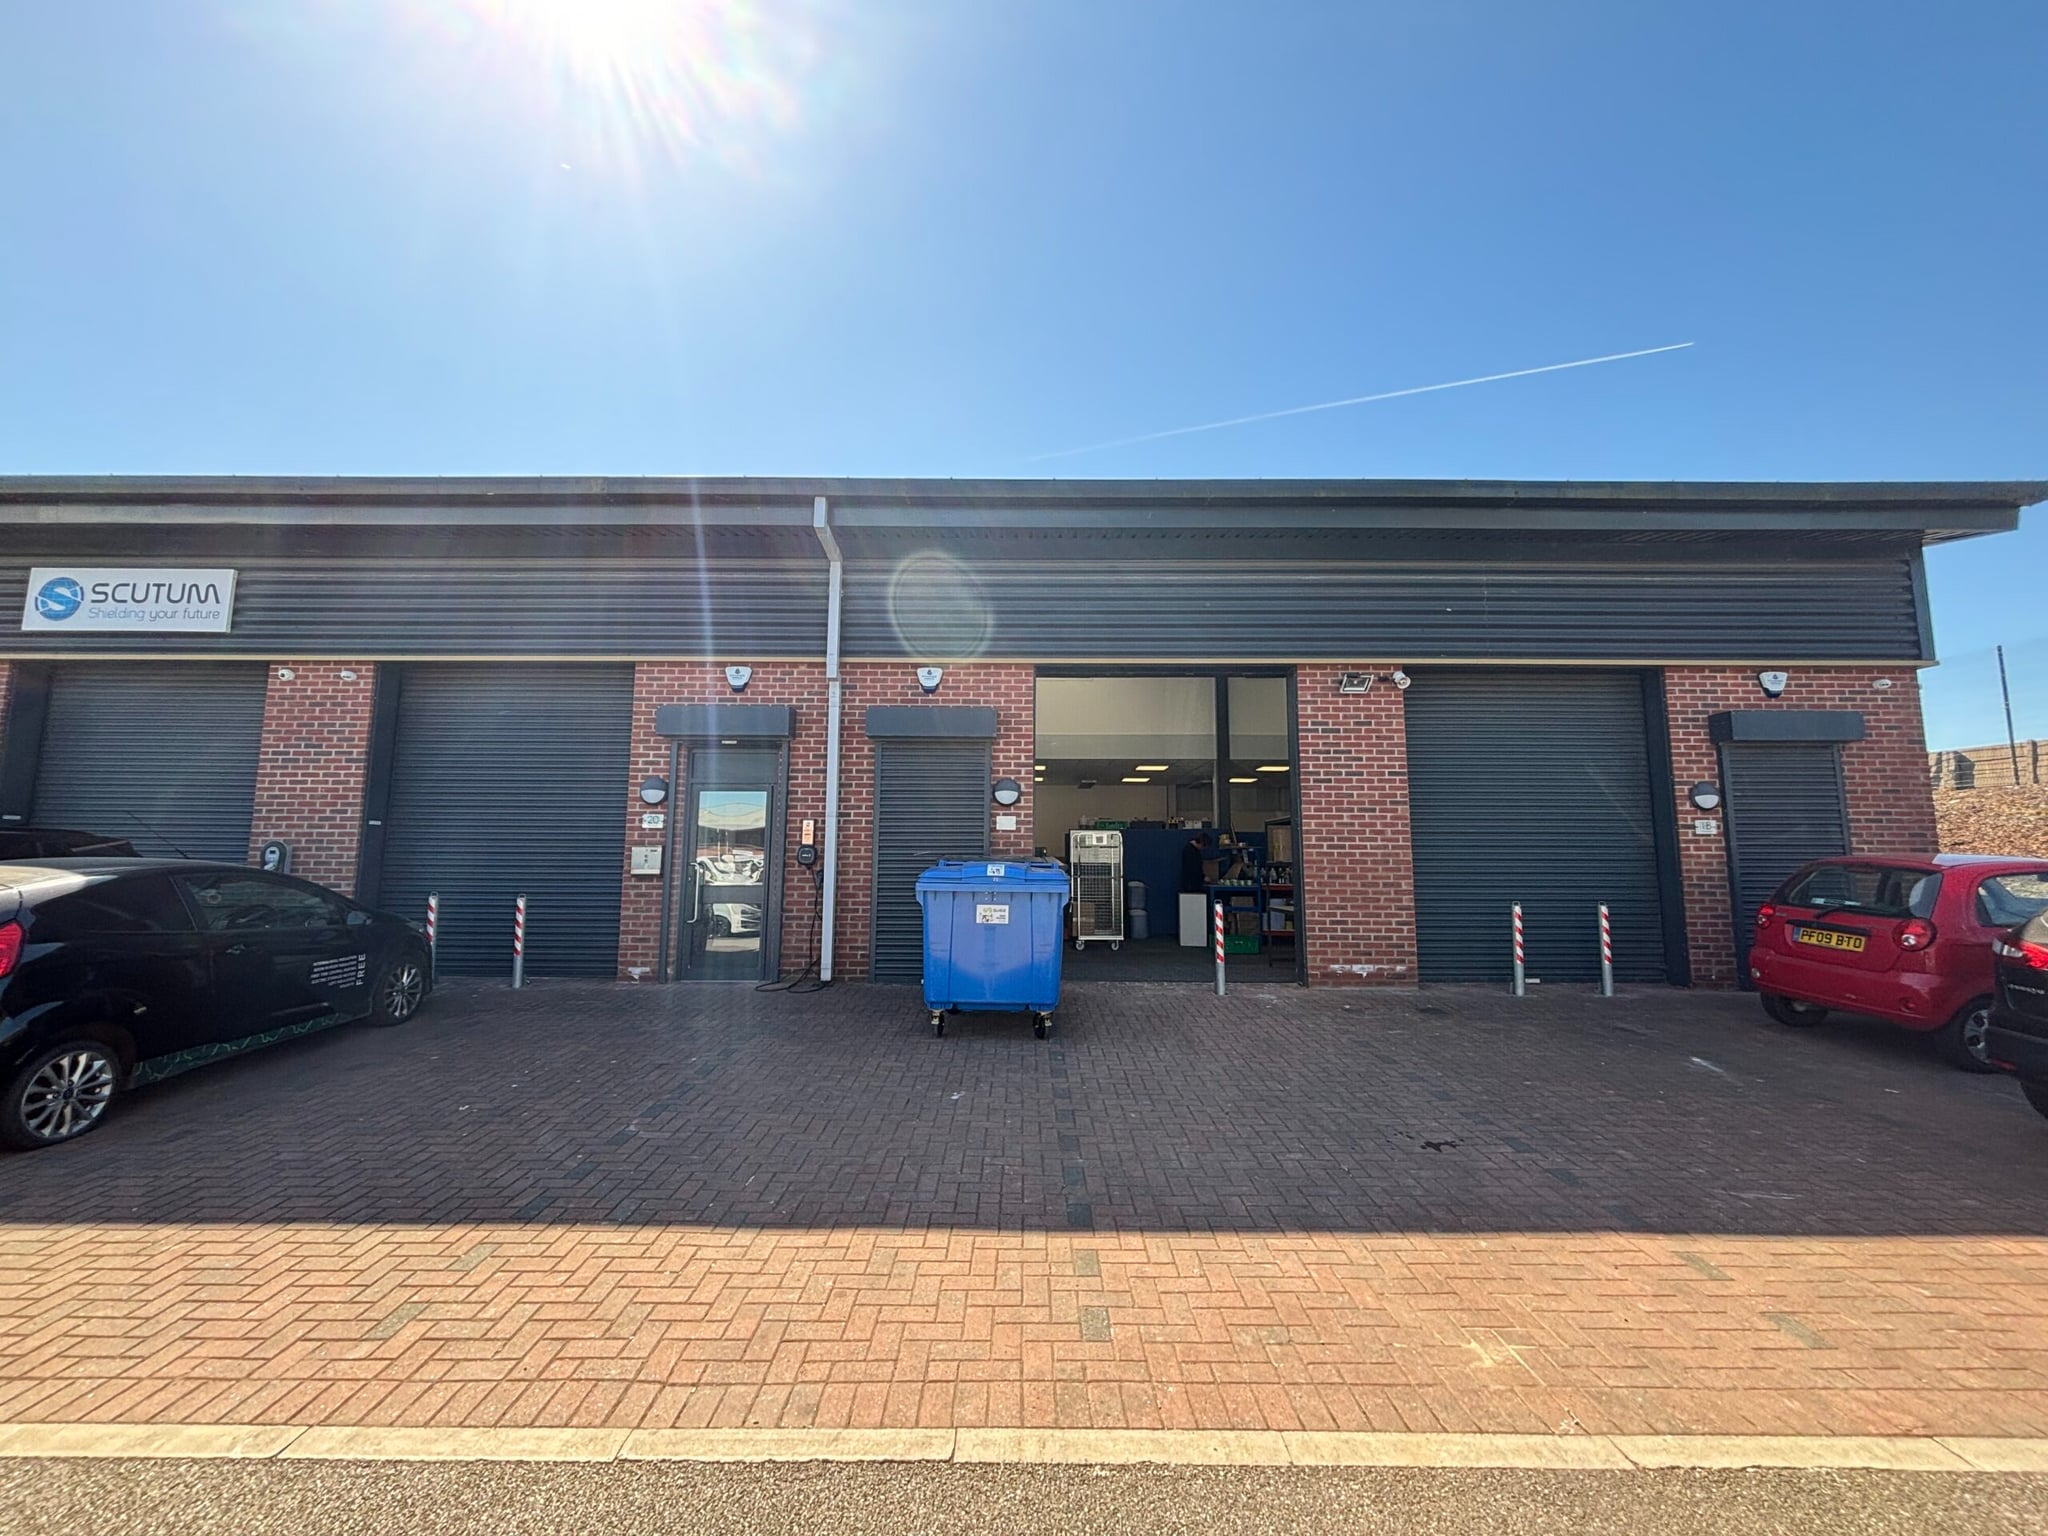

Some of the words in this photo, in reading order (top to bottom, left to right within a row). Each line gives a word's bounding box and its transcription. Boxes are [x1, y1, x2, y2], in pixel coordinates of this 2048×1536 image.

[90, 583, 220, 604] SCUTUM
[88, 607, 145, 622] Shielding
[149, 610, 178, 622] your
[183, 607, 220, 620] future
[647, 815, 660, 825] 20
[1800, 929, 1833, 944] PF09
[1835, 934, 1863, 949] BTO
[355, 953, 366, 986] FREE
